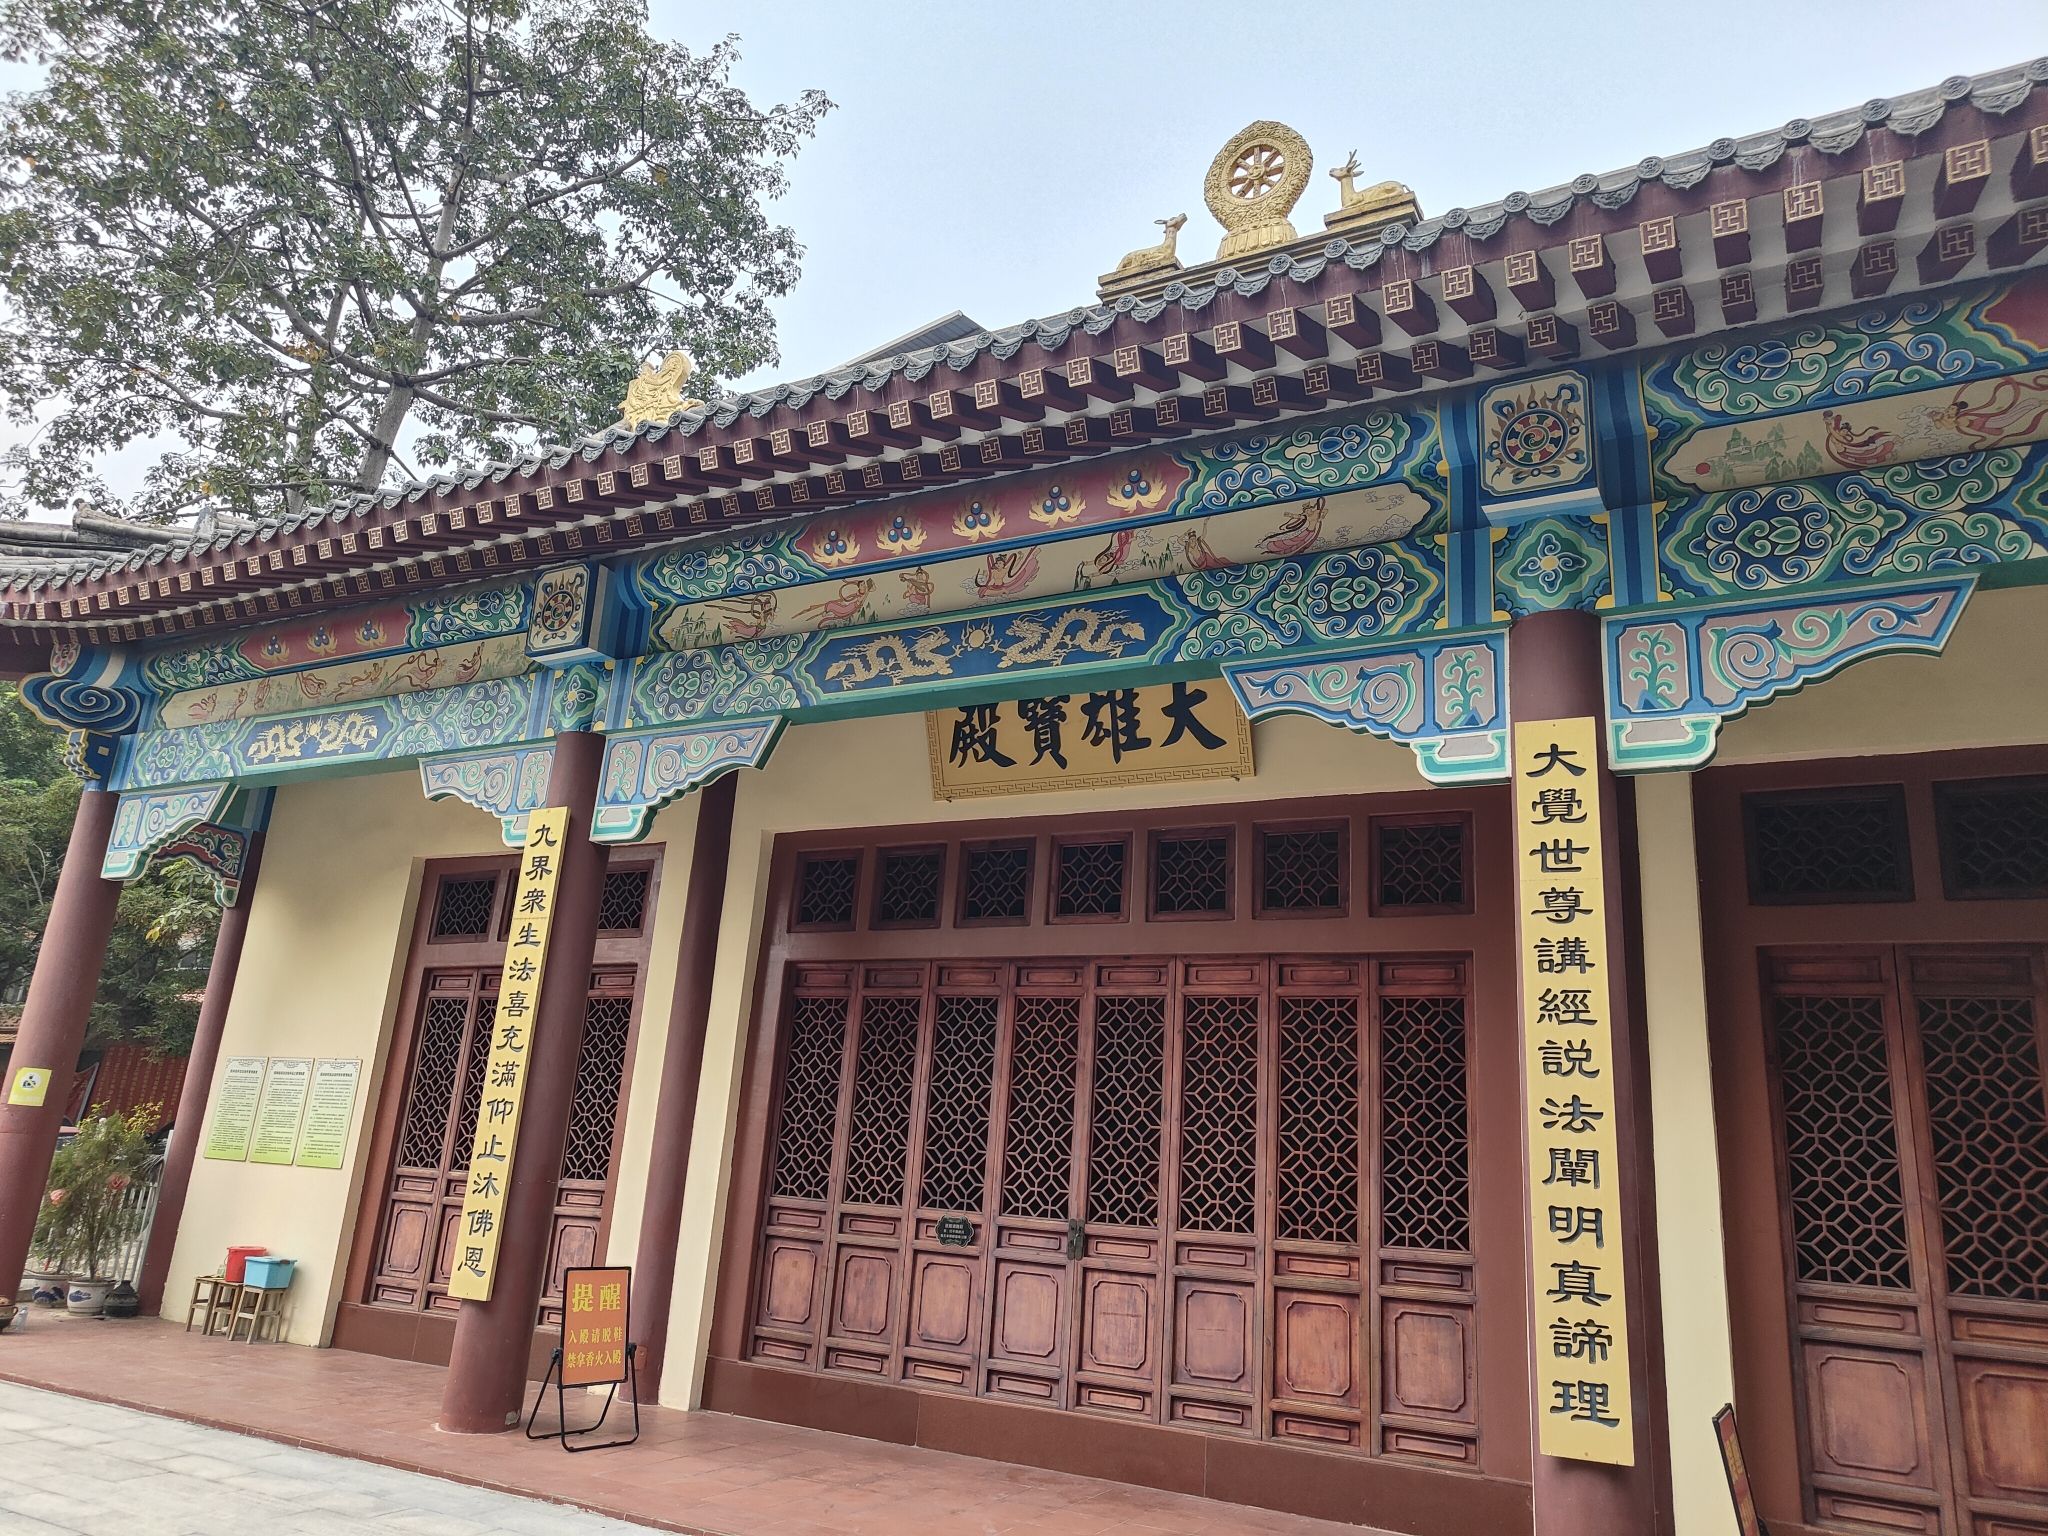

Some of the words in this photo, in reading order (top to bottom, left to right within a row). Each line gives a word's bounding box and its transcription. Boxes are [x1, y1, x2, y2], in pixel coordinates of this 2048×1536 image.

[949, 682, 1228, 769] 大雄寶殿
[571, 1283, 621, 1312] 提醒
